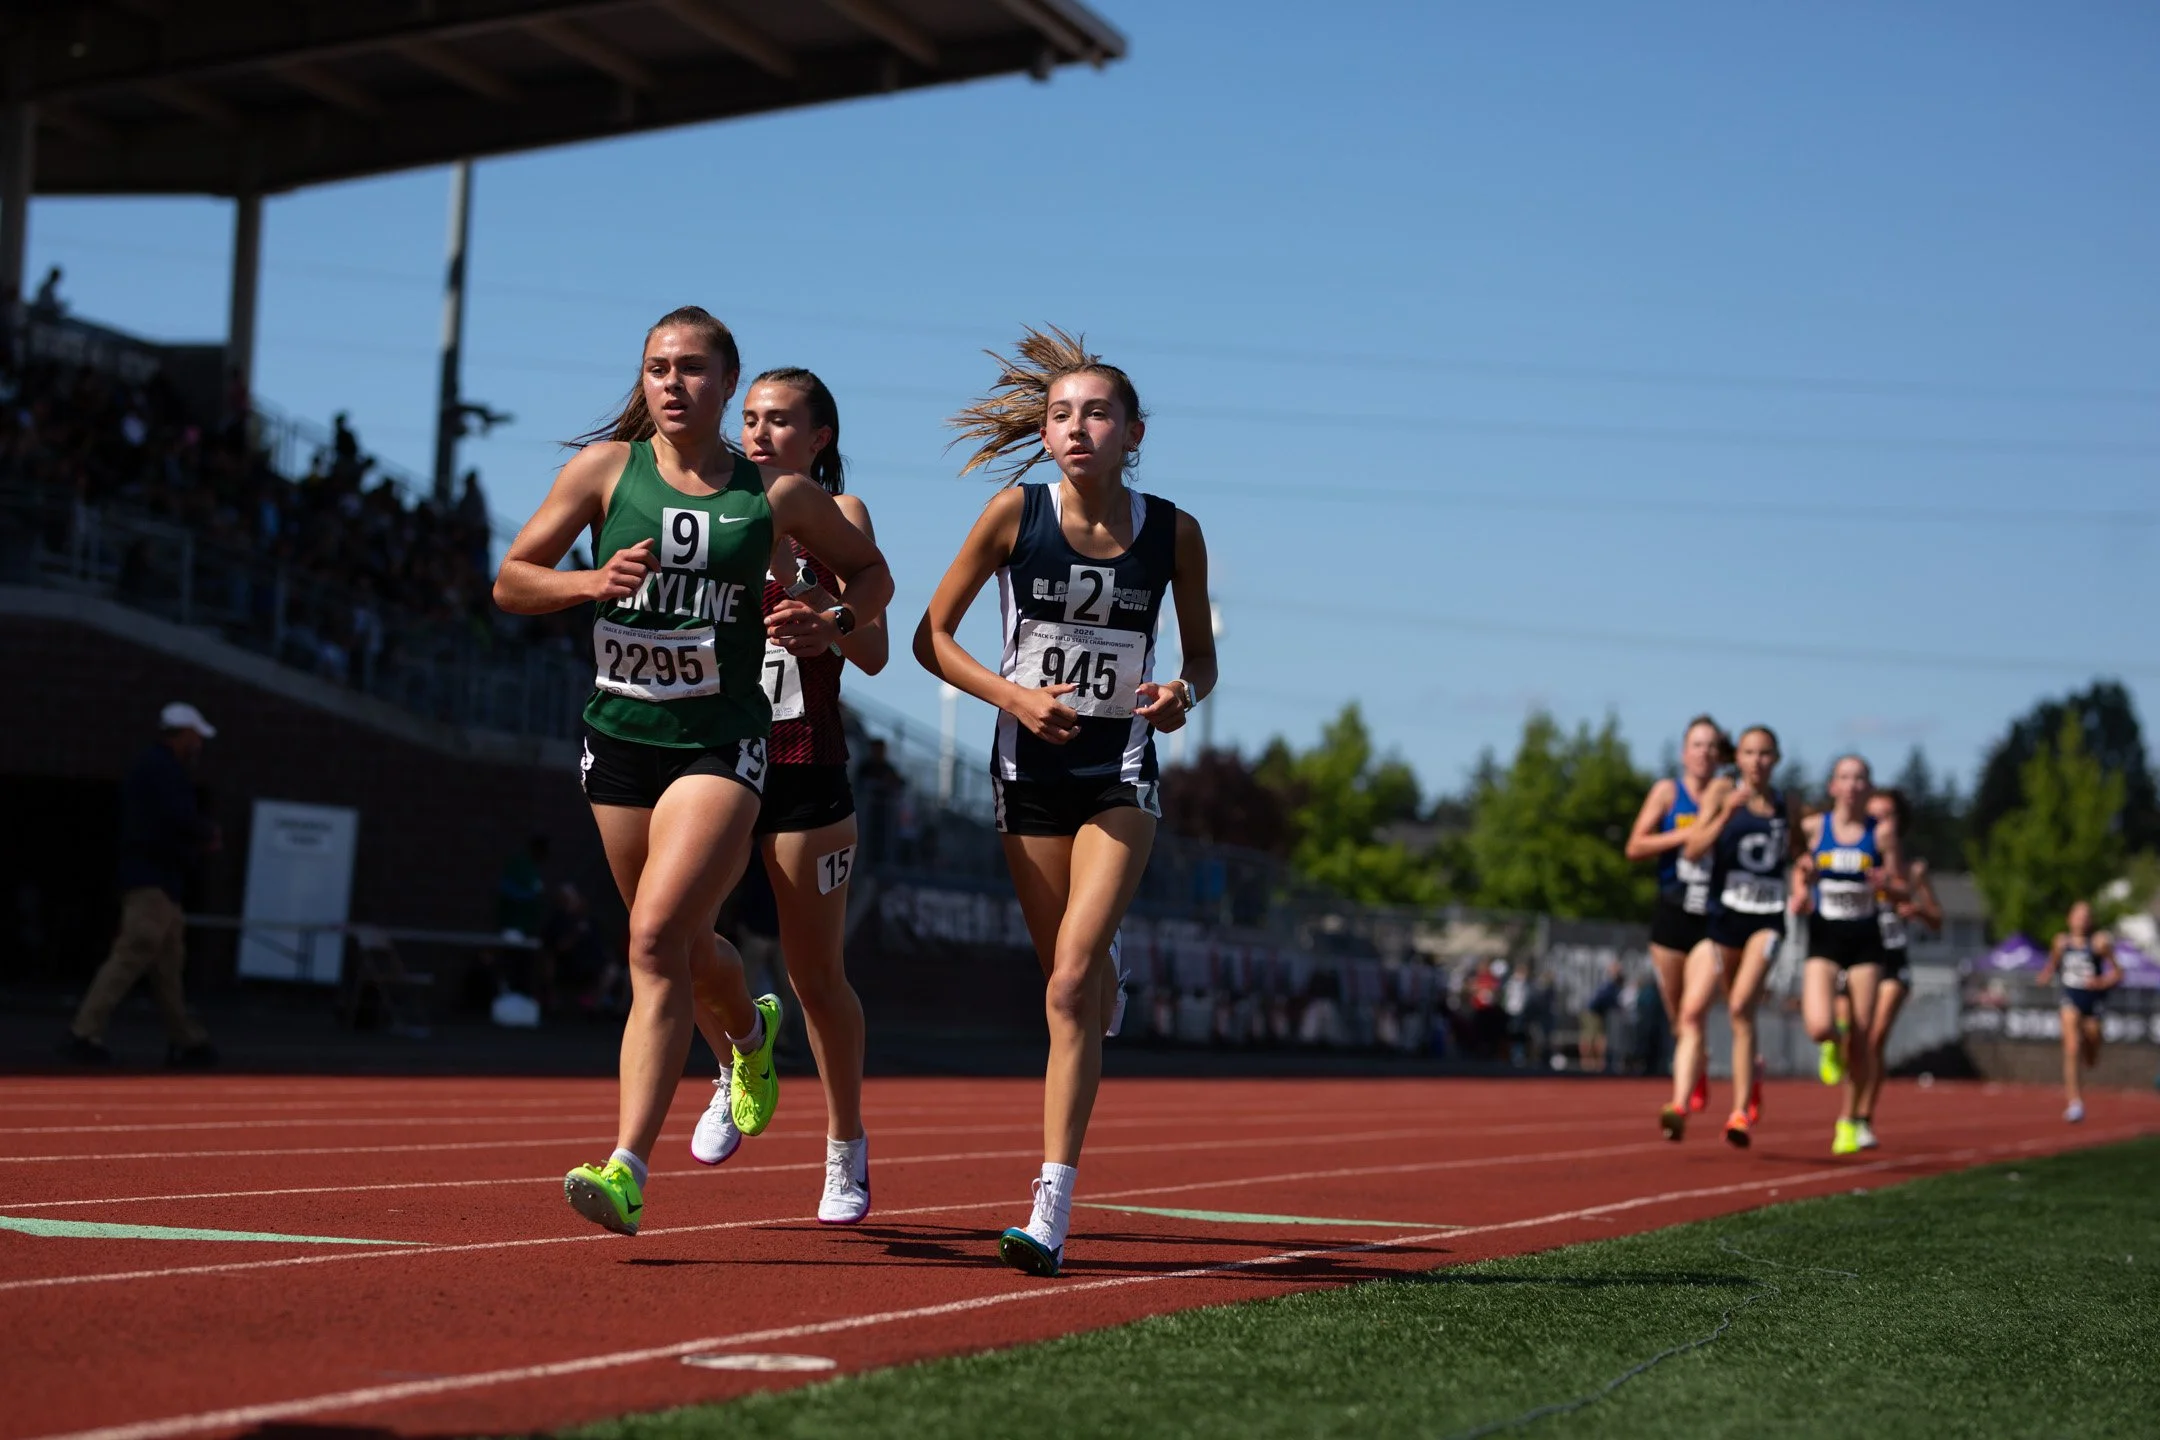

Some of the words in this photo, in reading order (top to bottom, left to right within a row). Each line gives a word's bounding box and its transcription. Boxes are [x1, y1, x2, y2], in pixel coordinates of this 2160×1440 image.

[672, 511, 699, 565] 9
[1073, 570, 1104, 622] 2
[1031, 631, 1049, 640] TRACK
[1072, 637, 1088, 645] STATE
[1089, 639, 1135, 649] CHAMPIONSHIPS
[1074, 627, 1095, 636] 2026
[605, 638, 704, 687] 2295
[765, 659, 785, 704] 7
[1040, 646, 1118, 701] 945
[746, 737, 765, 781] 9
[825, 848, 851, 888] 15
